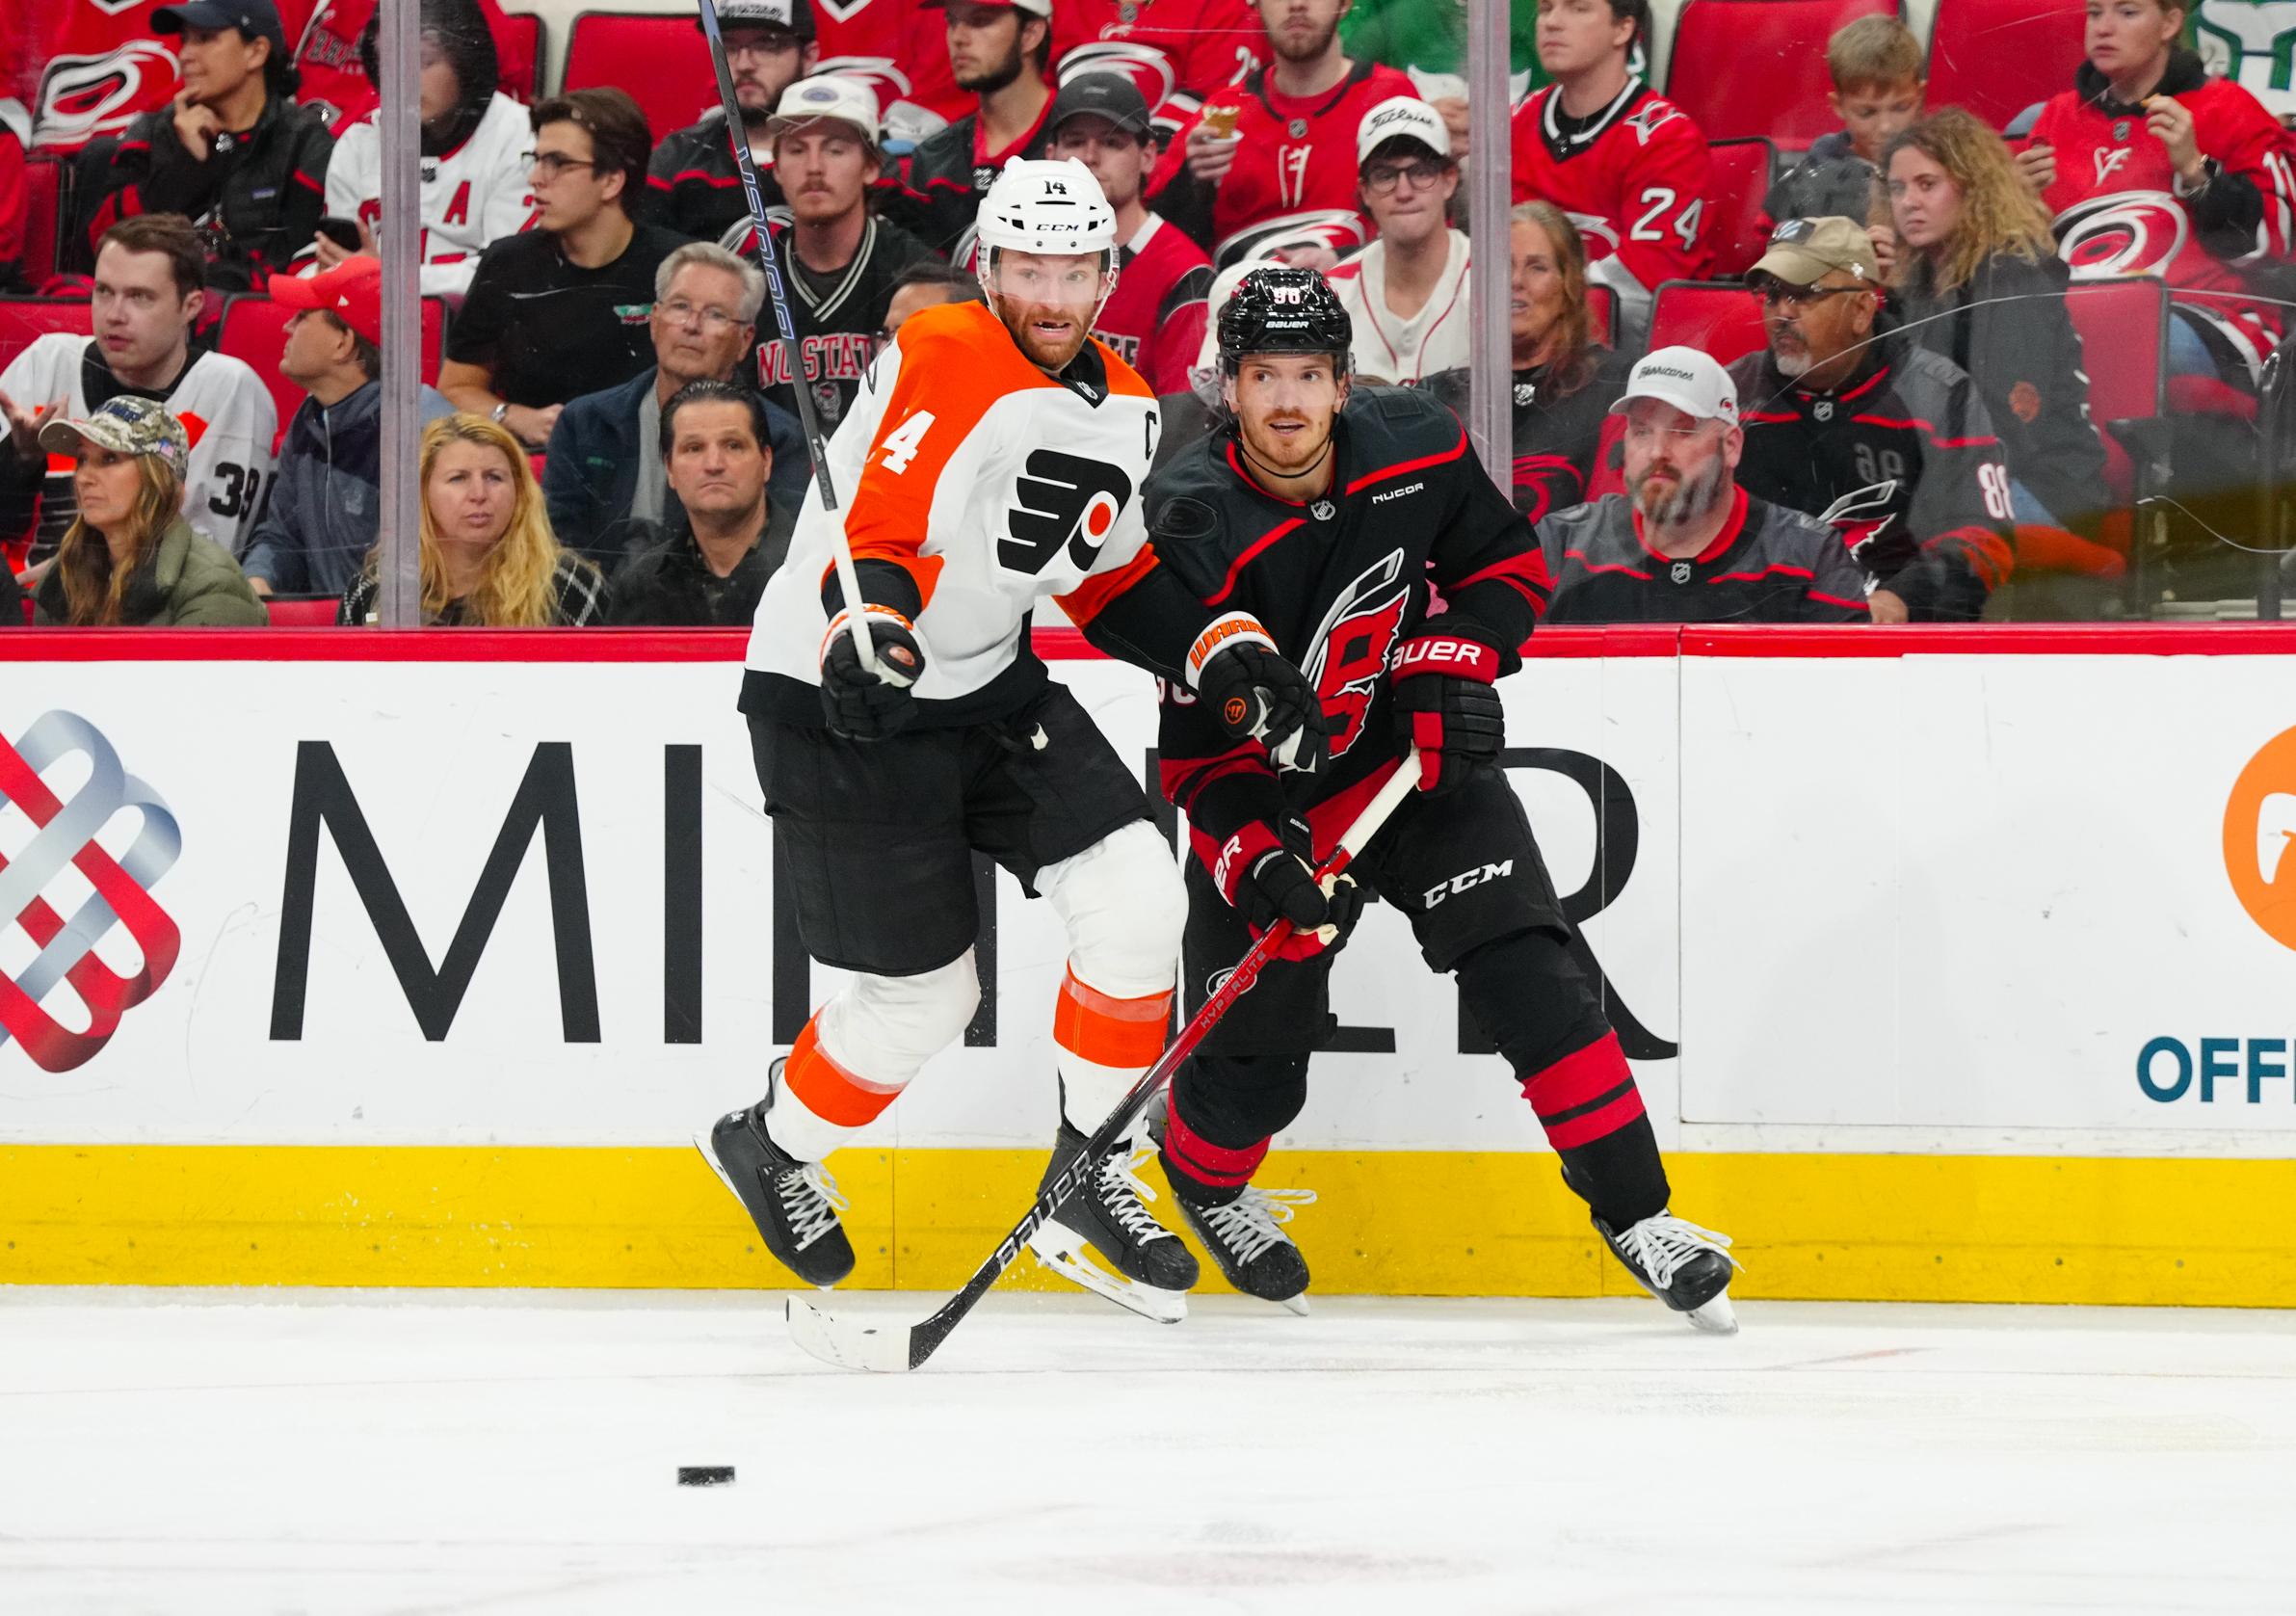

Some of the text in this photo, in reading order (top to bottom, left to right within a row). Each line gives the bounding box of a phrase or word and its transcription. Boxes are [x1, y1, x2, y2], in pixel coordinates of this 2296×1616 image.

[443, 180, 470, 225] A
[1044, 179, 1067, 195] 14
[1630, 187, 1703, 252] 24
[1638, 365, 1695, 381] Hurricanes
[208, 462, 260, 523] 39
[1372, 482, 1424, 504] NUCOR
[1390, 640, 1482, 672] AUER
[1422, 859, 1514, 909] CCM
[2137, 1036, 2296, 1104] OFF
[996, 1151, 1094, 1273] BAUER
